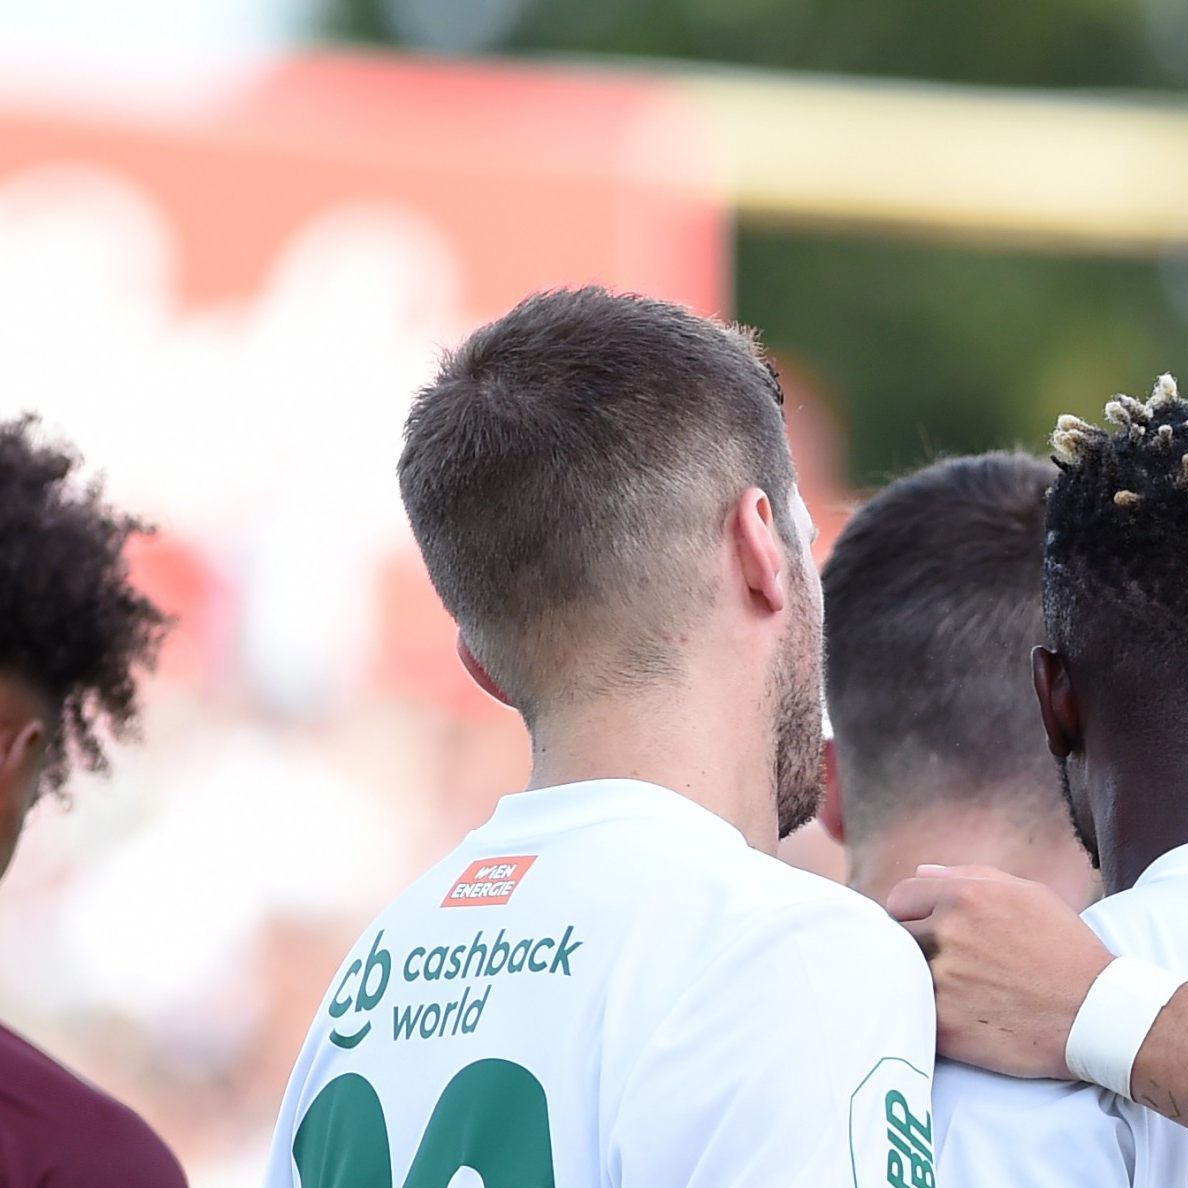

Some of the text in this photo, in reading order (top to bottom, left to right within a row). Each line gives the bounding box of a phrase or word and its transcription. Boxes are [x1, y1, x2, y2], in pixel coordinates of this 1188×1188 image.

[451, 881, 516, 899] ENERGIE
[474, 864, 518, 880] WIEN
[403, 925, 584, 982] cashback
[393, 984, 492, 1041] world
